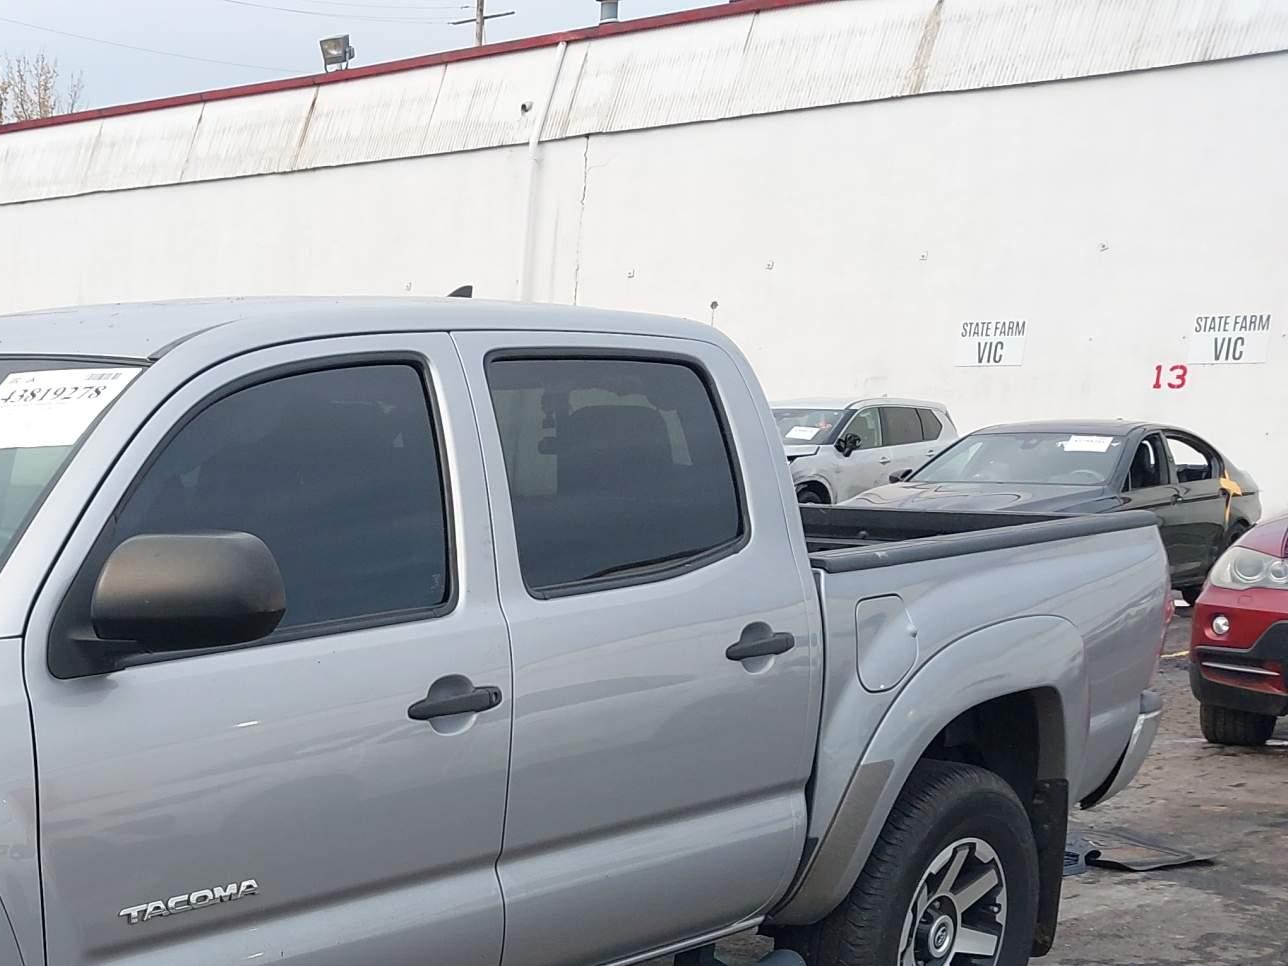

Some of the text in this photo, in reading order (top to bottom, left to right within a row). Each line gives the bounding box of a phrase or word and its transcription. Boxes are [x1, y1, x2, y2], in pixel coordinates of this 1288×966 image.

[960, 320, 1026, 338] STATE FARM
[1194, 314, 1271, 333] STATE FARM
[976, 341, 1004, 364] VIC
[1213, 336, 1245, 361] VIC
[1152, 364, 1188, 390] 13
[0, 385, 107, 403] 43819278
[119, 879, 260, 924] TACOMA
